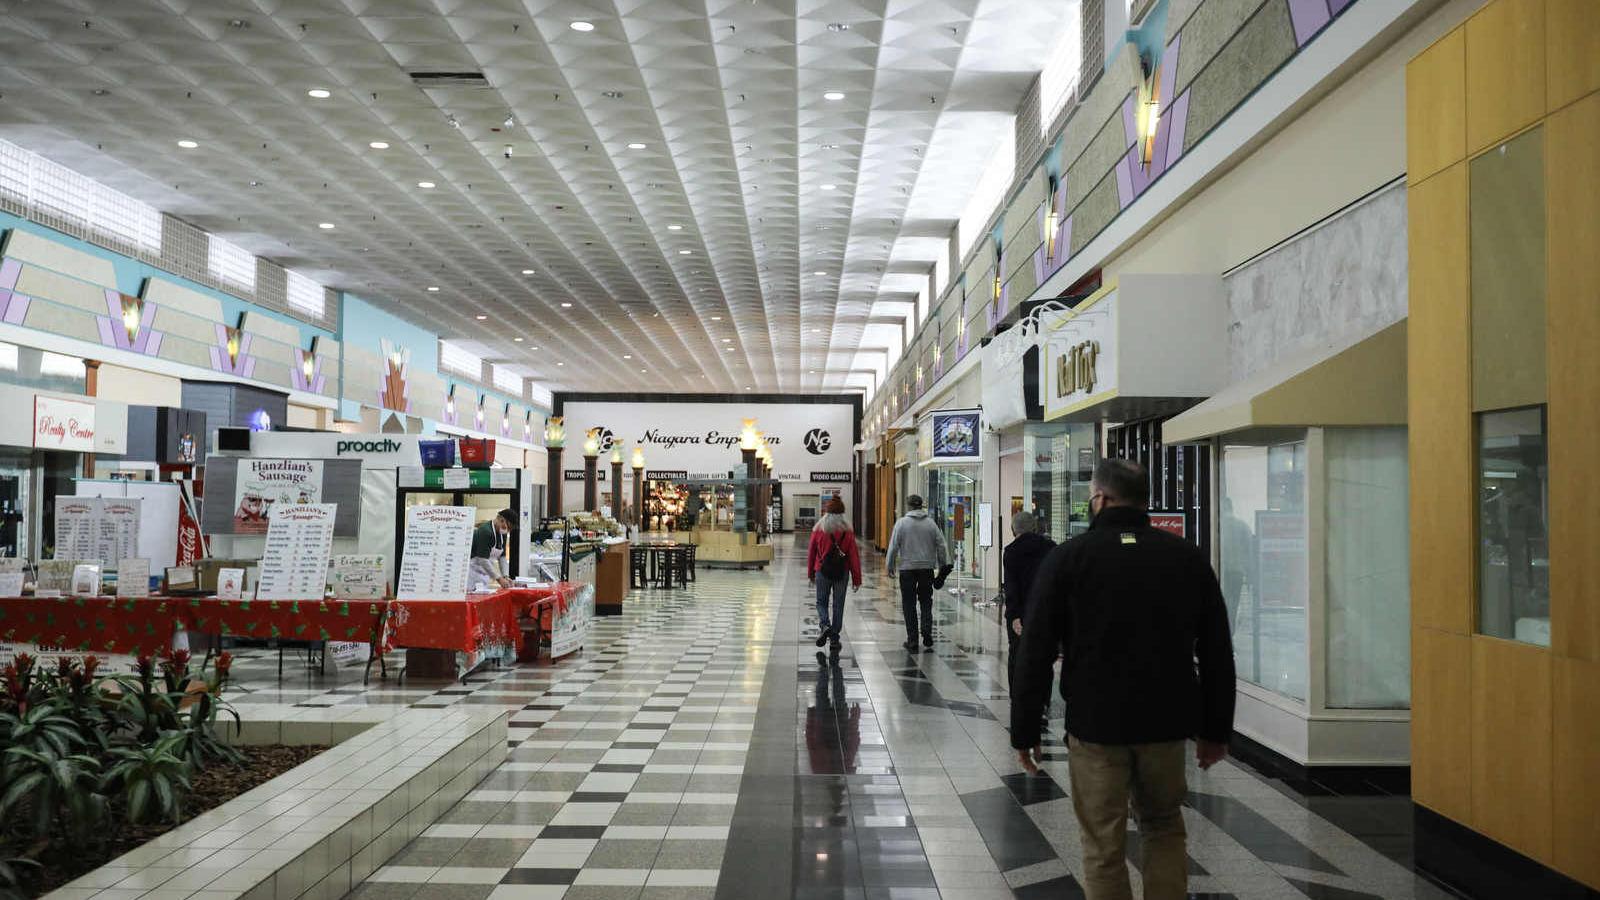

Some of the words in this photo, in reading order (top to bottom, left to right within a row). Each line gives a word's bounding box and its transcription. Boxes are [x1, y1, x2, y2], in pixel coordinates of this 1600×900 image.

[40, 416, 65, 443] Realty
[637, 428, 700, 449] Niagara
[337, 438, 402, 456] proactiv
[252, 459, 313, 474] Hanzlian's
[258, 470, 307, 483] Sausage
[647, 471, 686, 479] COLLECTIBLES
[778, 472, 801, 480] VINTAGE
[812, 472, 829, 480] VIDEO
[830, 472, 849, 480] GAMES
